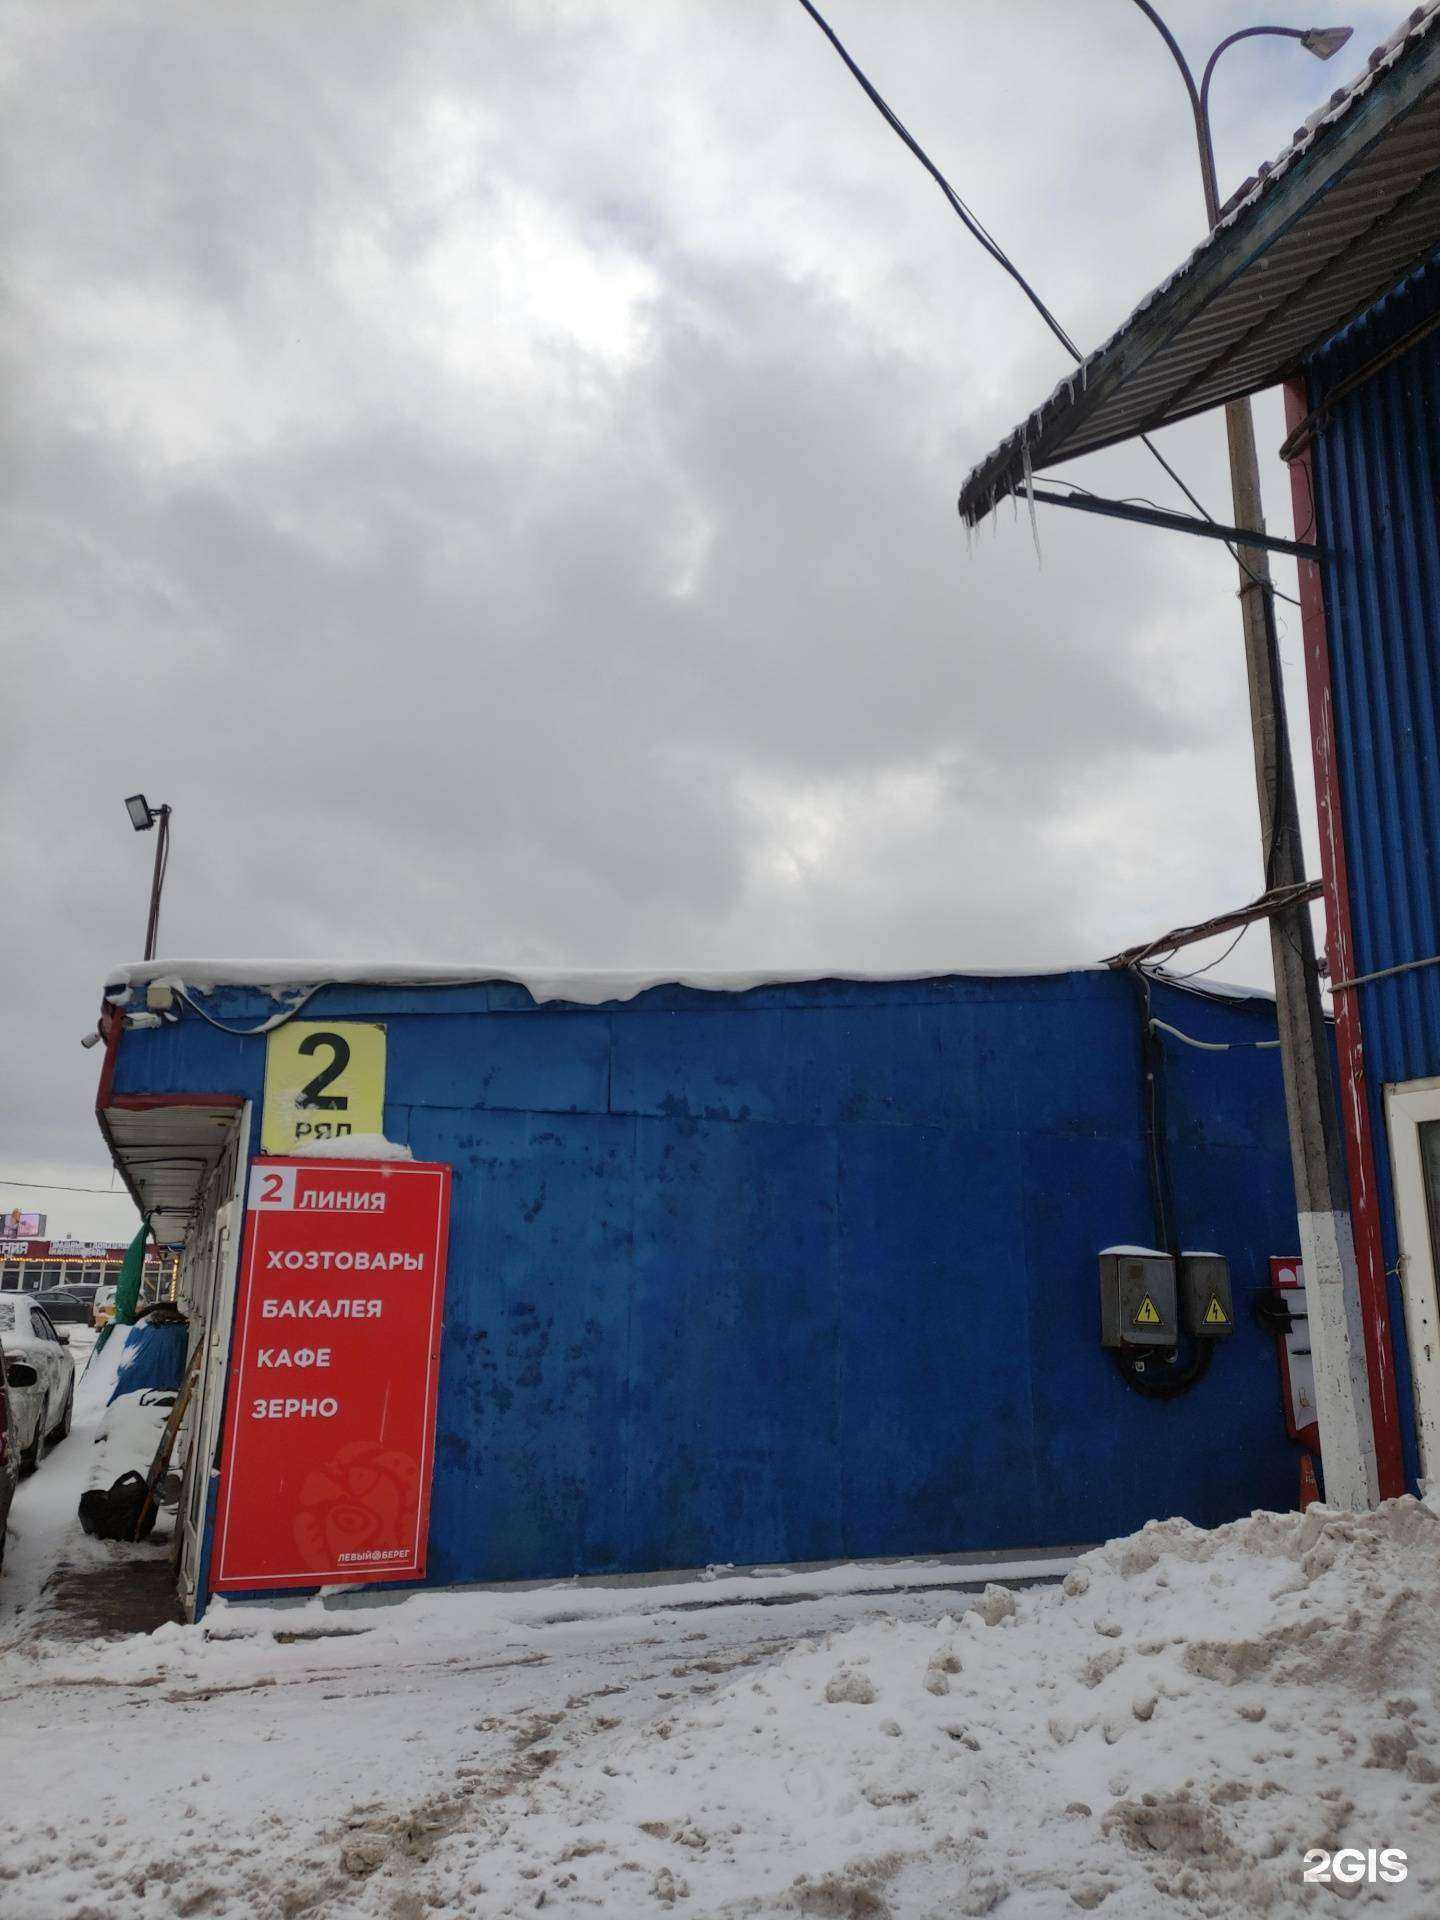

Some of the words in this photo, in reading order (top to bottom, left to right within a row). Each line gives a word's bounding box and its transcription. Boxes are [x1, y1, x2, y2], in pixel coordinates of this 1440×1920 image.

[297, 1032, 350, 1110] 2
[260, 1174, 284, 1202] 2
[300, 1191, 386, 1210] ЛИНИЯ
[267, 1250, 424, 1270] ХОЗТОВАРЫ
[262, 1299, 382, 1318] БАКАЛЕЯ
[257, 1348, 332, 1369] КАФЕ
[251, 1398, 338, 1418] ЗЕРНО
[338, 1551, 372, 1561] ЛЕВЫЙ
[382, 1550, 409, 1558] БЕРЕГ
